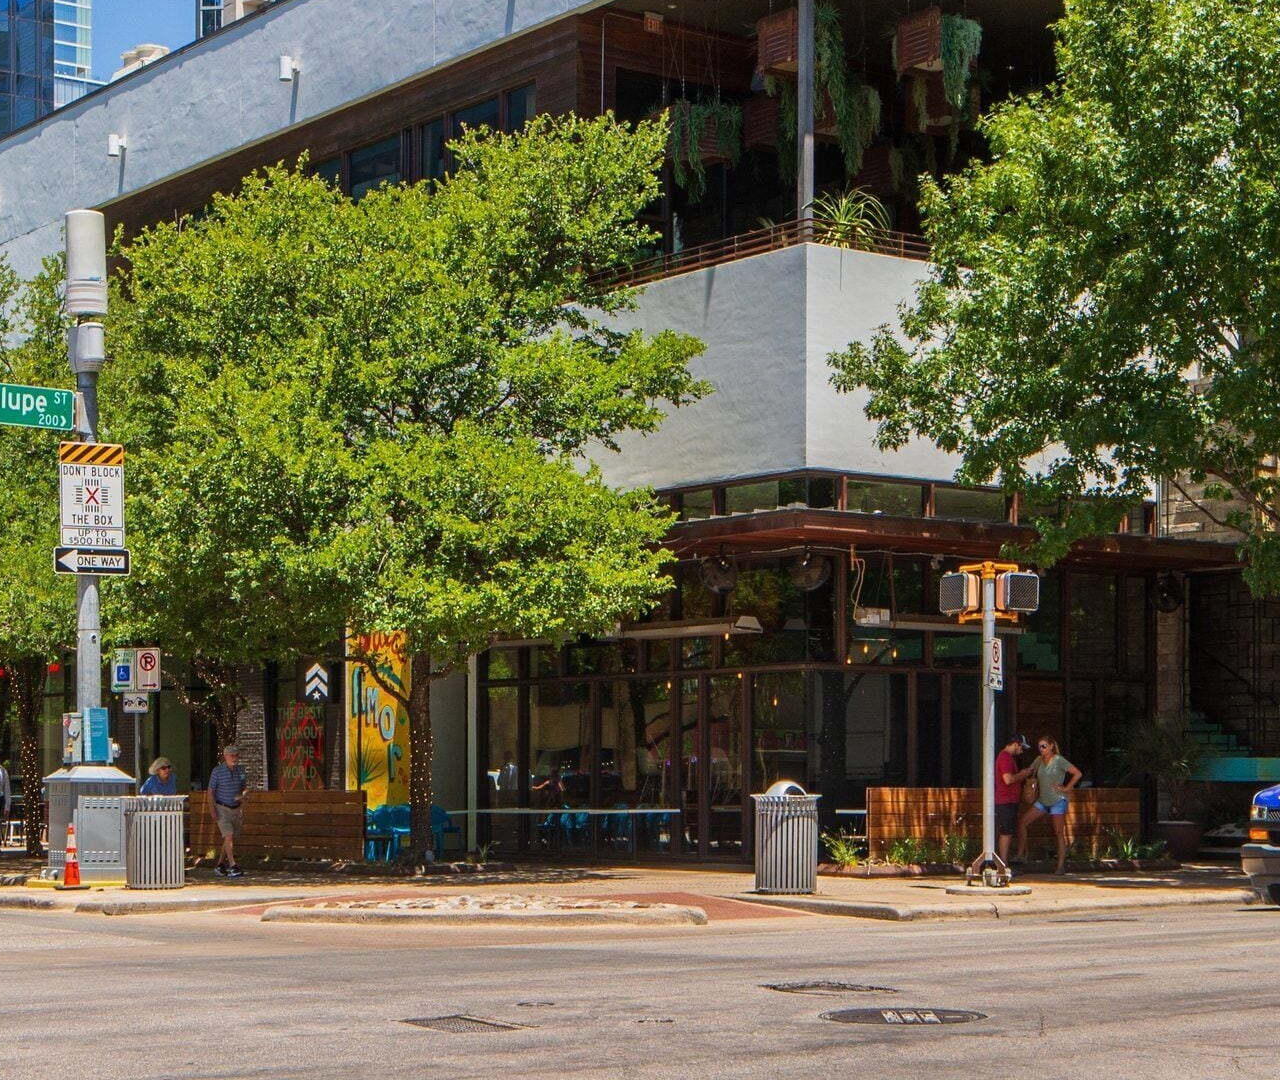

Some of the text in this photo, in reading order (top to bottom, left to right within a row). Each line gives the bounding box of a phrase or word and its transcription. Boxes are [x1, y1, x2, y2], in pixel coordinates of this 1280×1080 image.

[53, 392, 67, 405] ST
[38, 413, 59, 426] 200
[91, 467, 120, 478] BLOCK
[72, 514, 113, 525] THE BOX
[78, 529, 107, 537] UP TO
[69, 537, 116, 546] $500 FINE
[77, 556, 122, 567] ONE WAY
[282, 765, 317, 778] WORLD
